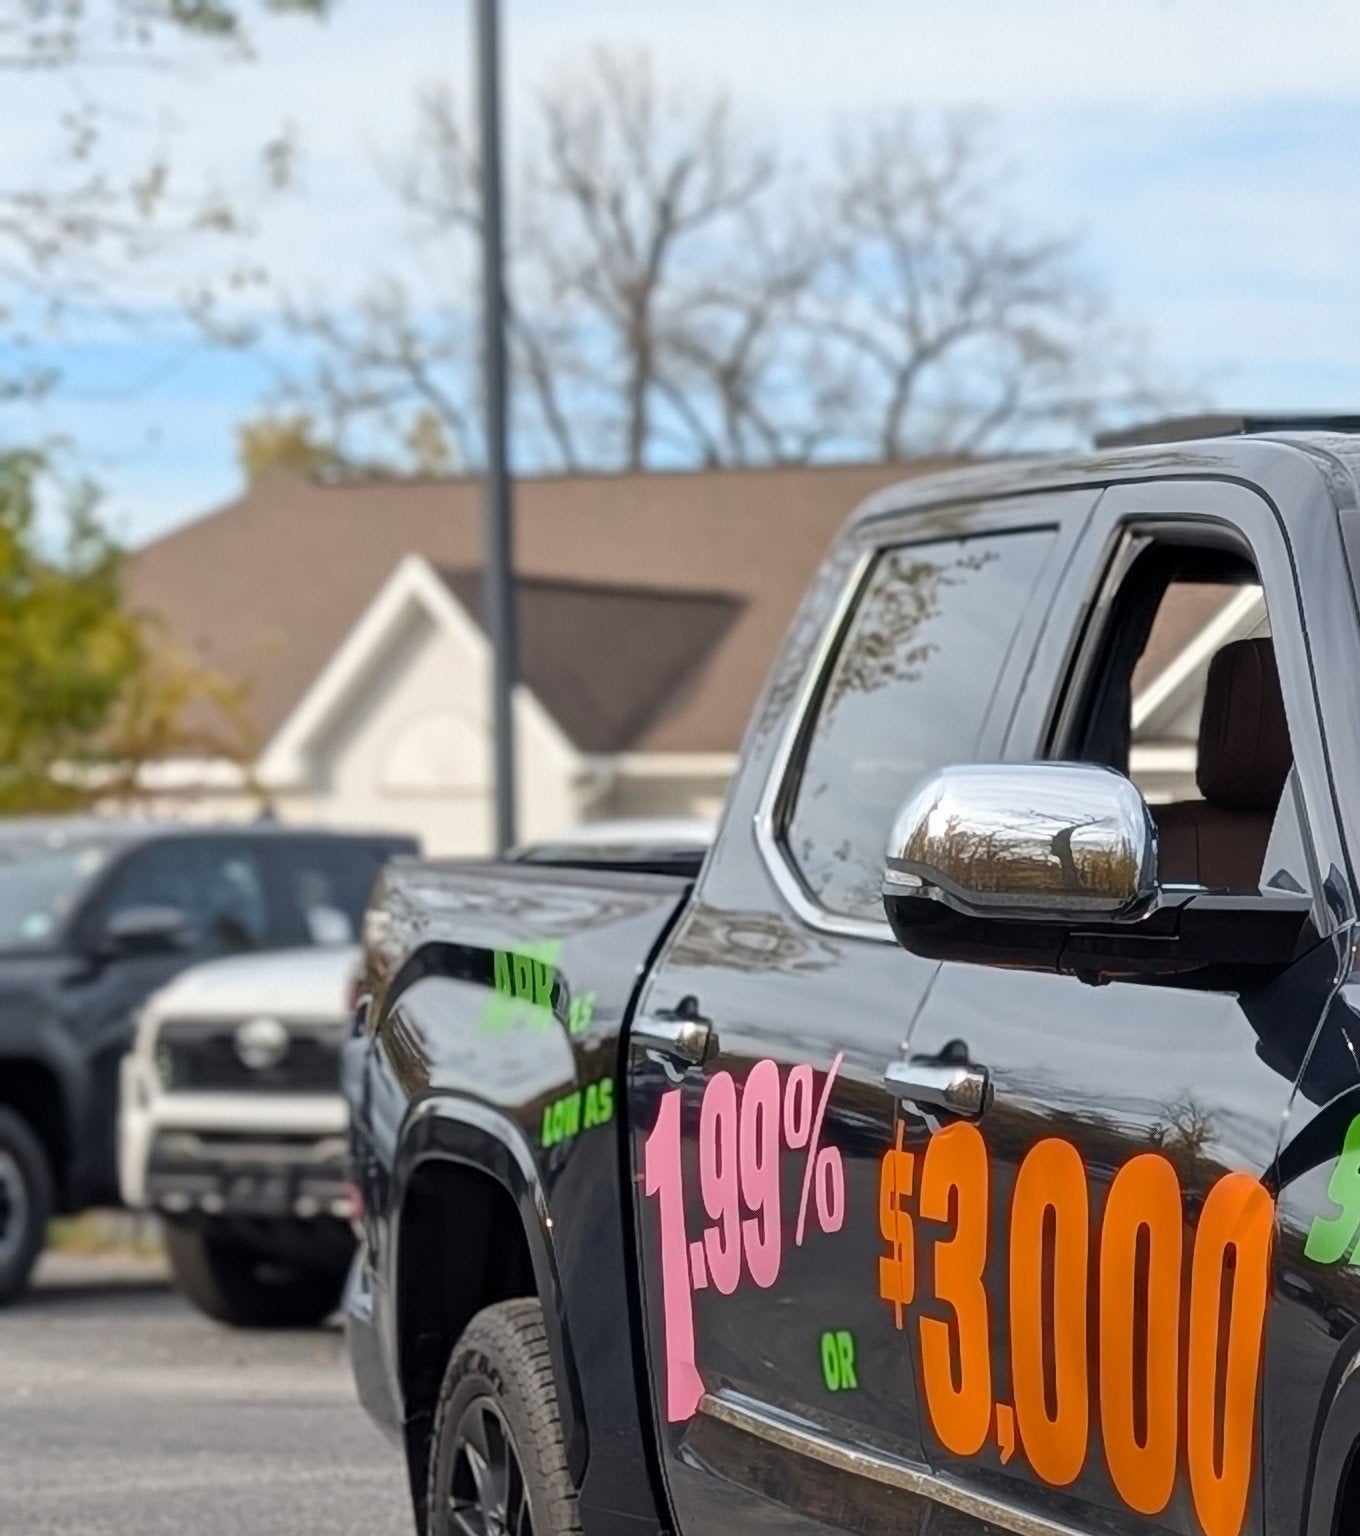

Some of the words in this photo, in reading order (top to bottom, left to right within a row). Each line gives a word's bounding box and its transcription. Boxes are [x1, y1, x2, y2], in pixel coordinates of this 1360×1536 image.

[584, 1077, 614, 1130] AS
[645, 1051, 845, 1422] 1.99%
[822, 1331, 858, 1391] OR
